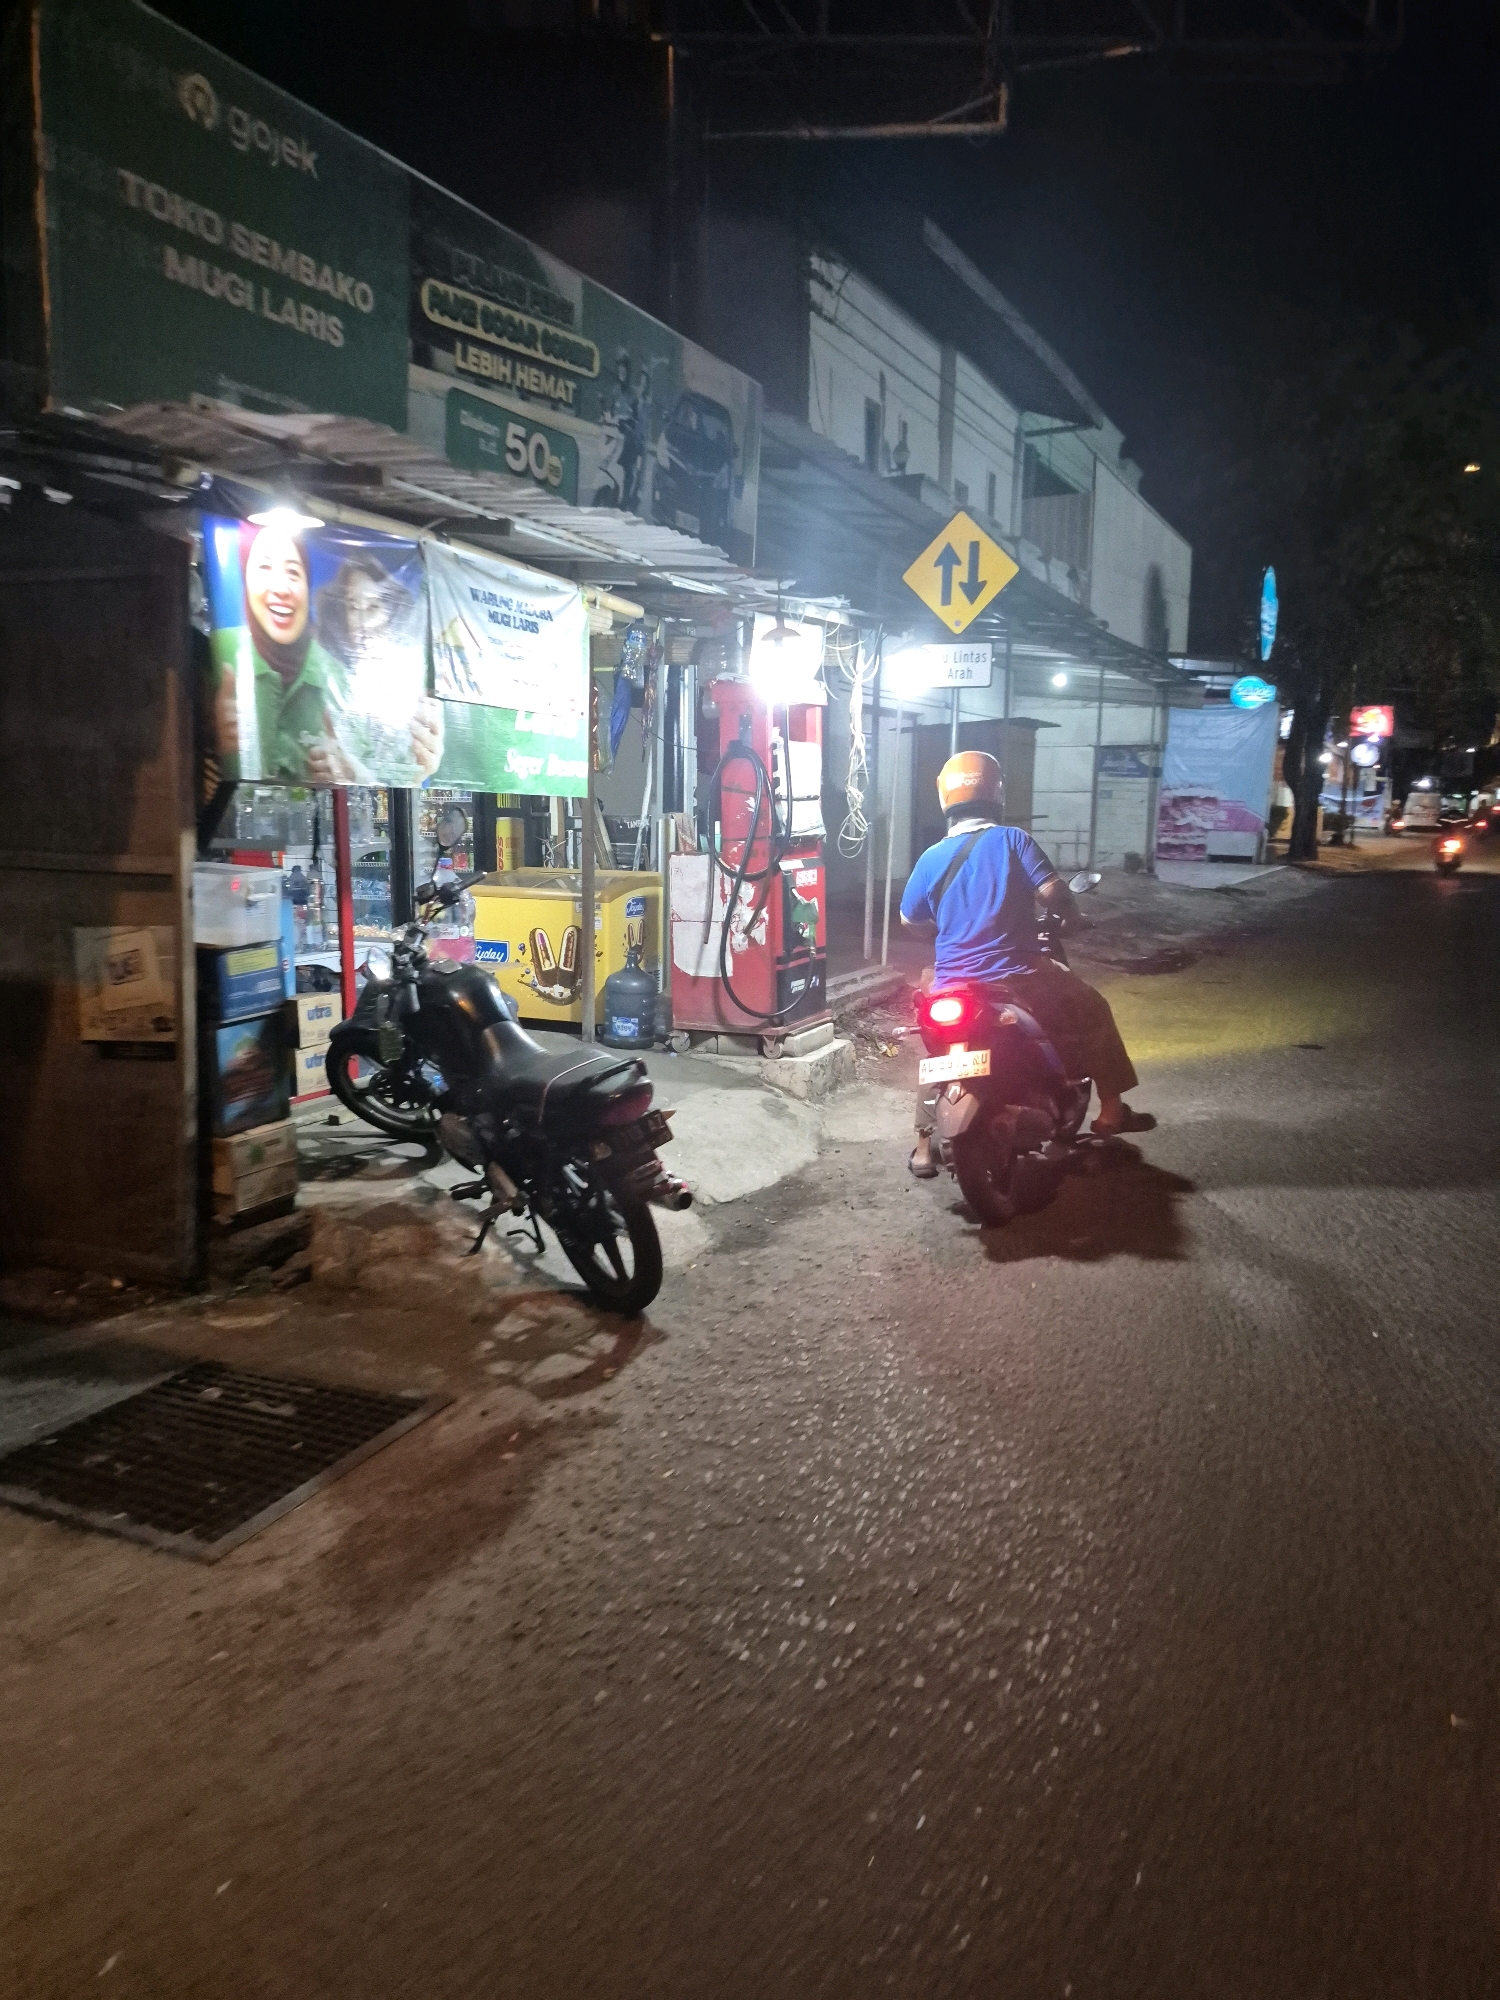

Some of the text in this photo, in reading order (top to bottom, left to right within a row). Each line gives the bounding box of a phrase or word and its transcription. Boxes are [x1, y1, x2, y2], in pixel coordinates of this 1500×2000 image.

[228, 105, 319, 180] gojek
[117, 167, 374, 313] TOKO SEMBAKO
[163, 245, 344, 347] MUGI LARIS
[455, 342, 577, 404] LEBIH HEMAT
[505, 420, 549, 480] 50
[487, 609, 540, 635] MUGI LARIS
[947, 667, 973, 680] Arah
[953, 650, 987, 664] Lintas
